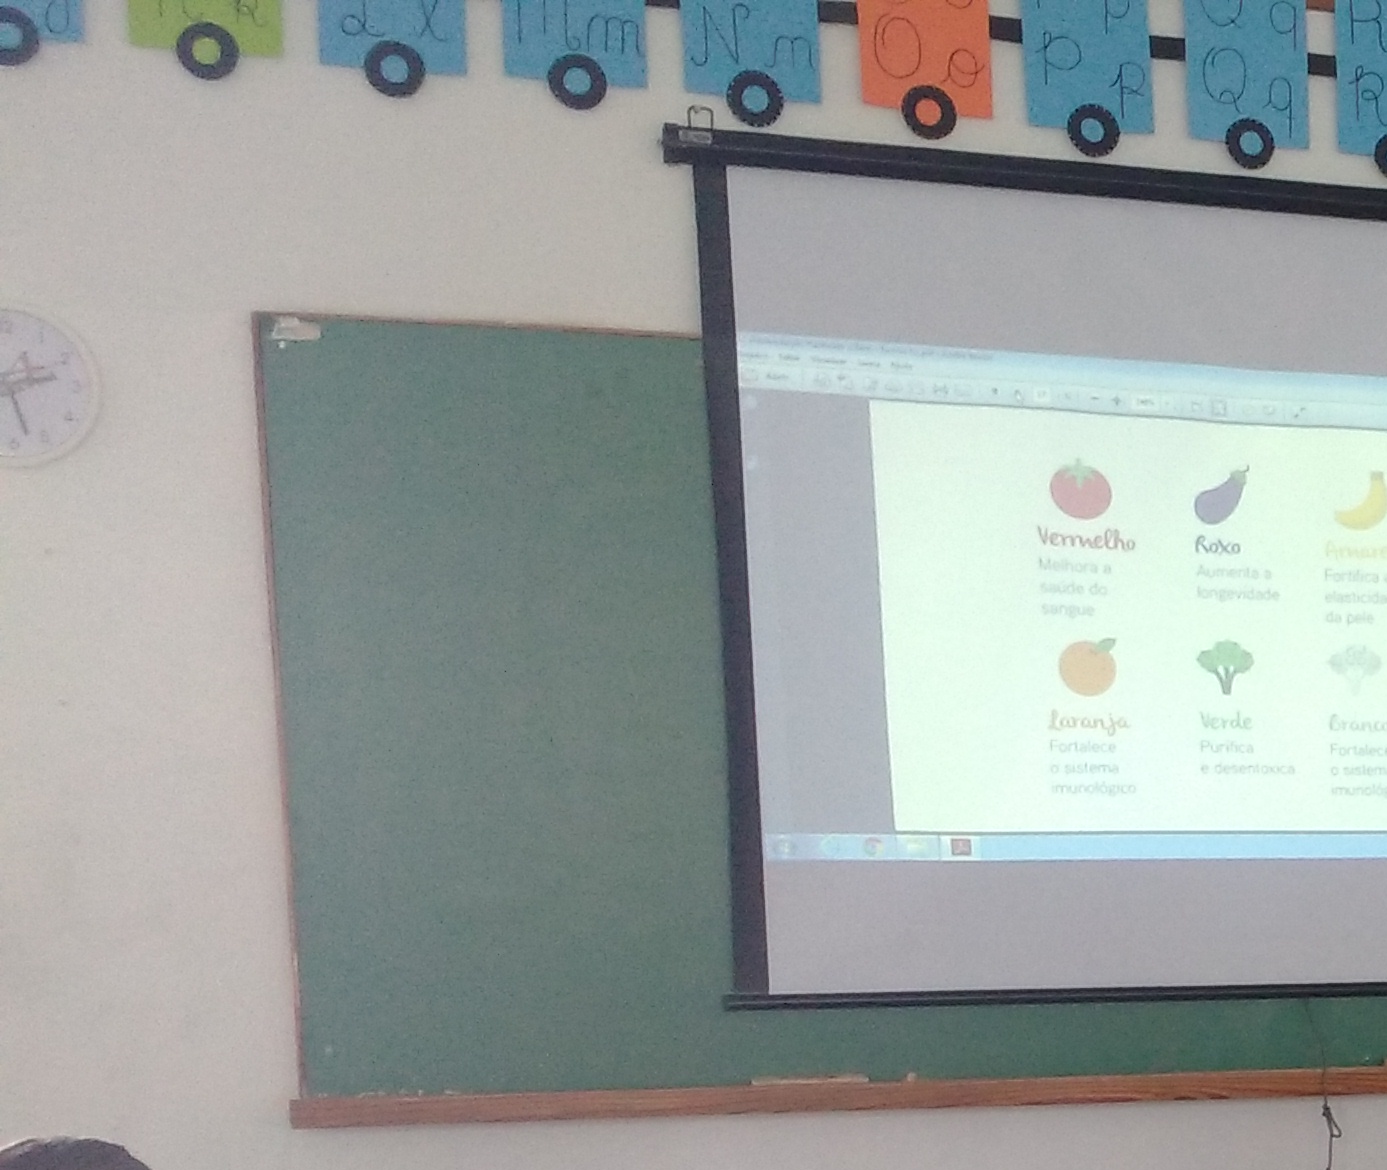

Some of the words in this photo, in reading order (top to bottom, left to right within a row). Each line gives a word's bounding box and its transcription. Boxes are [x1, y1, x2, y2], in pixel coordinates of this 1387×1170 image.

[1037, 526, 1136, 551] Vermelho
[1194, 534, 1242, 555] Roxo
[1038, 558, 1099, 575] Melhora
[1196, 565, 1259, 580] Aumenta
[1324, 568, 1380, 584] Fortifica
[1089, 583, 1108, 597] do
[1196, 586, 1281, 603] longevidade
[1041, 603, 1096, 619] sangue
[1047, 709, 1131, 736] Laranja
[1199, 710, 1254, 730] Verde
[1049, 739, 1117, 754] Fortalece
[1200, 739, 1255, 755] Purifica
[1064, 760, 1119, 775] sistema
